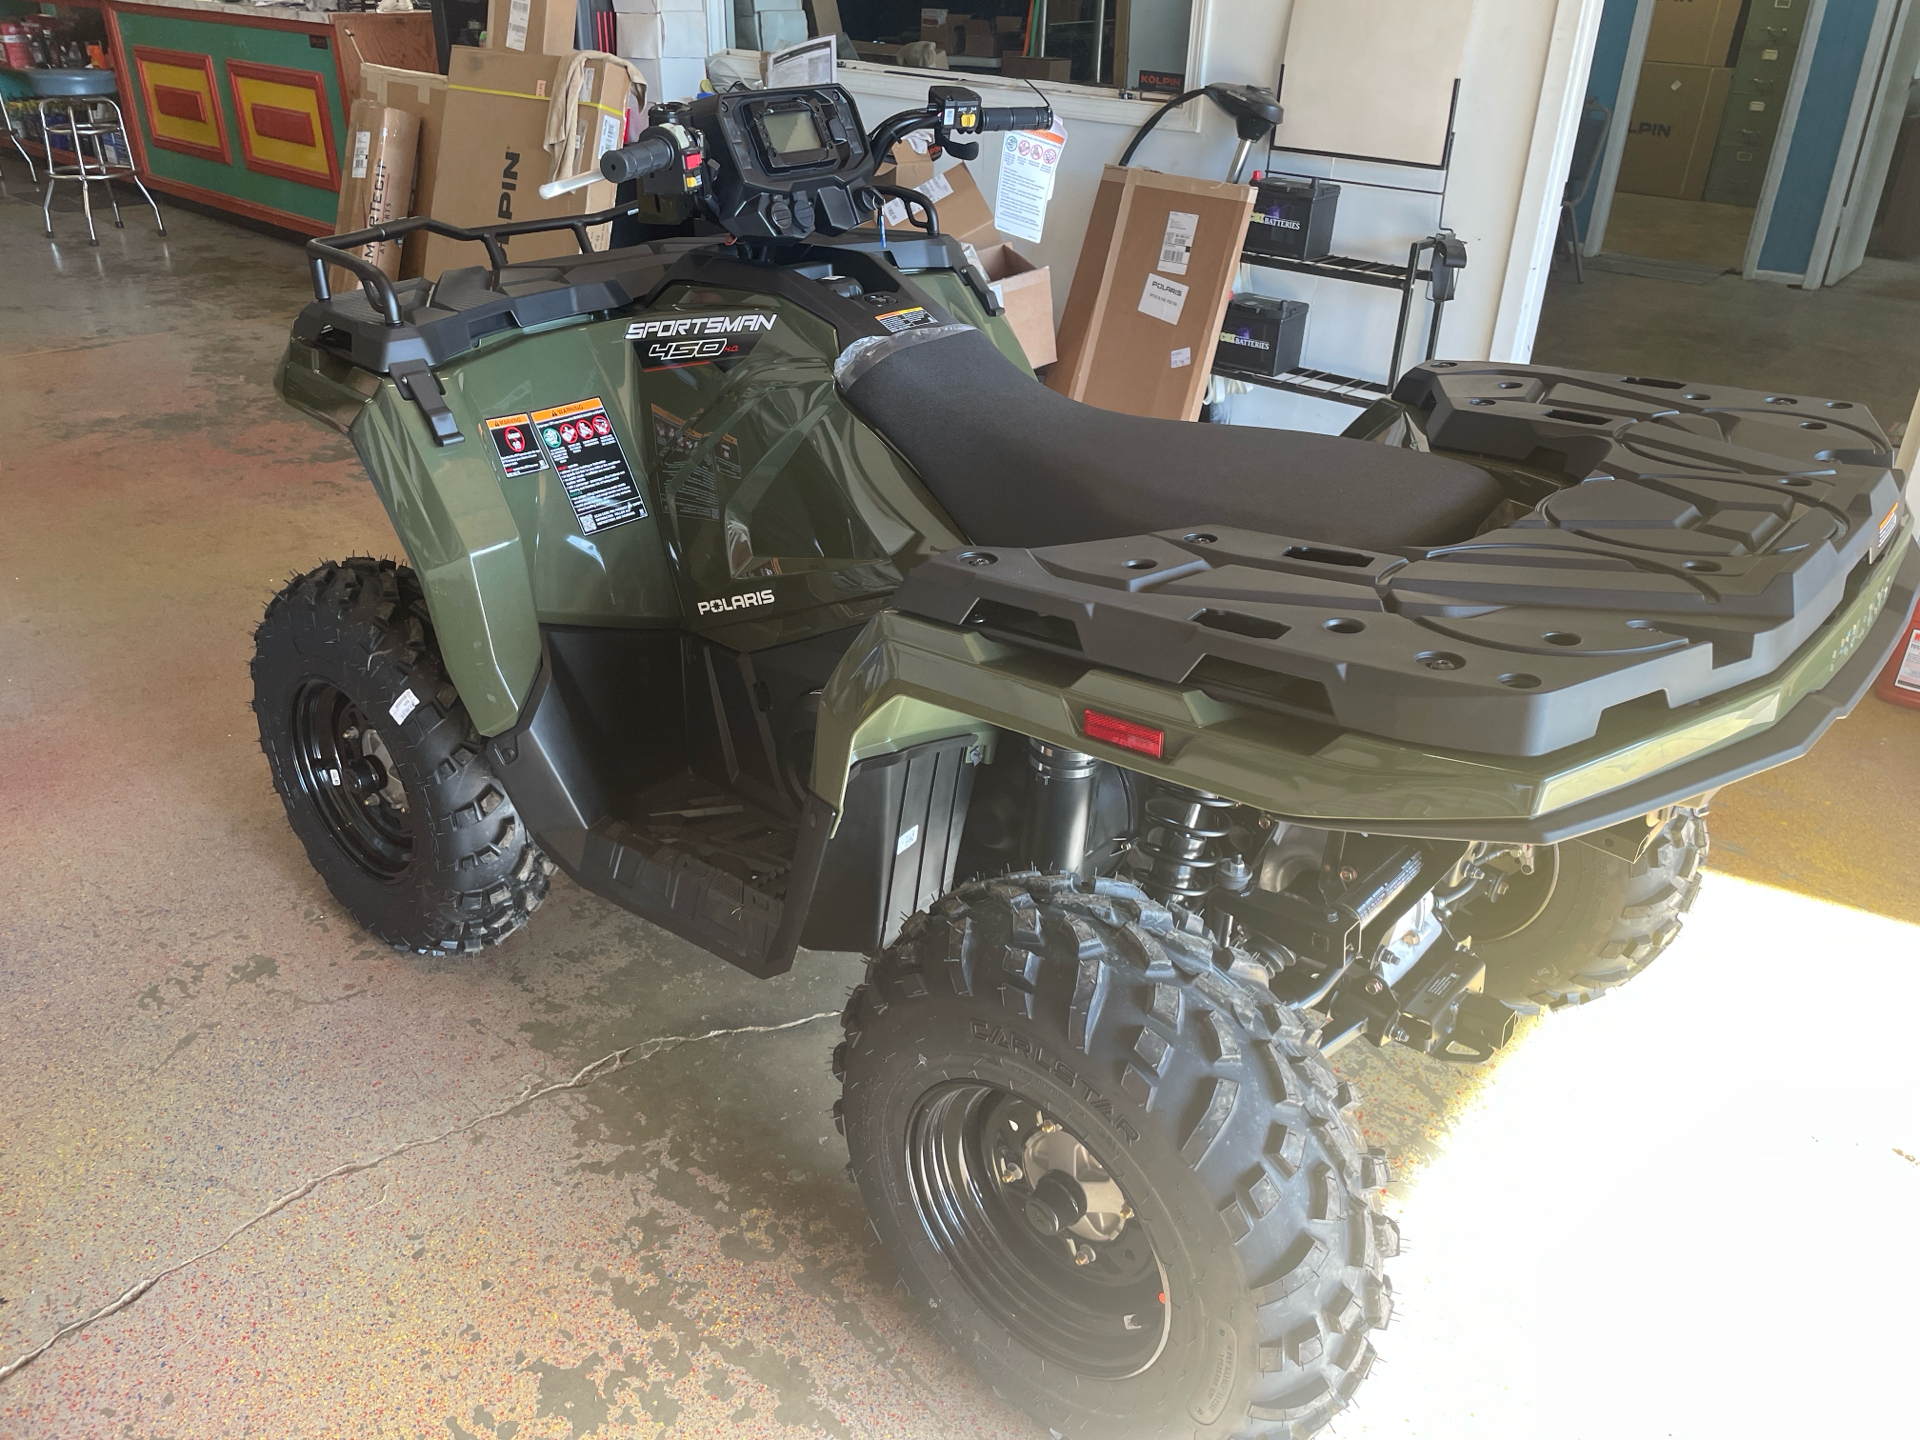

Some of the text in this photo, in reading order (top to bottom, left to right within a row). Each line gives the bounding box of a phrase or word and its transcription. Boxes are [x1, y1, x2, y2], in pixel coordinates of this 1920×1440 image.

[1140, 74, 1181, 87] KOLPIN
[1263, 216, 1301, 231] BATTERIES
[1151, 280, 1183, 298] POLARIS
[624, 313, 778, 340] SPORTSMAN
[648, 337, 729, 361] 450
[1234, 337, 1270, 351] BATTERIES
[558, 404, 584, 415] WARNING
[500, 416, 522, 426] WARNING
[697, 589, 775, 616] POLARIS
[969, 1018, 1141, 1147] CARLSTAR
